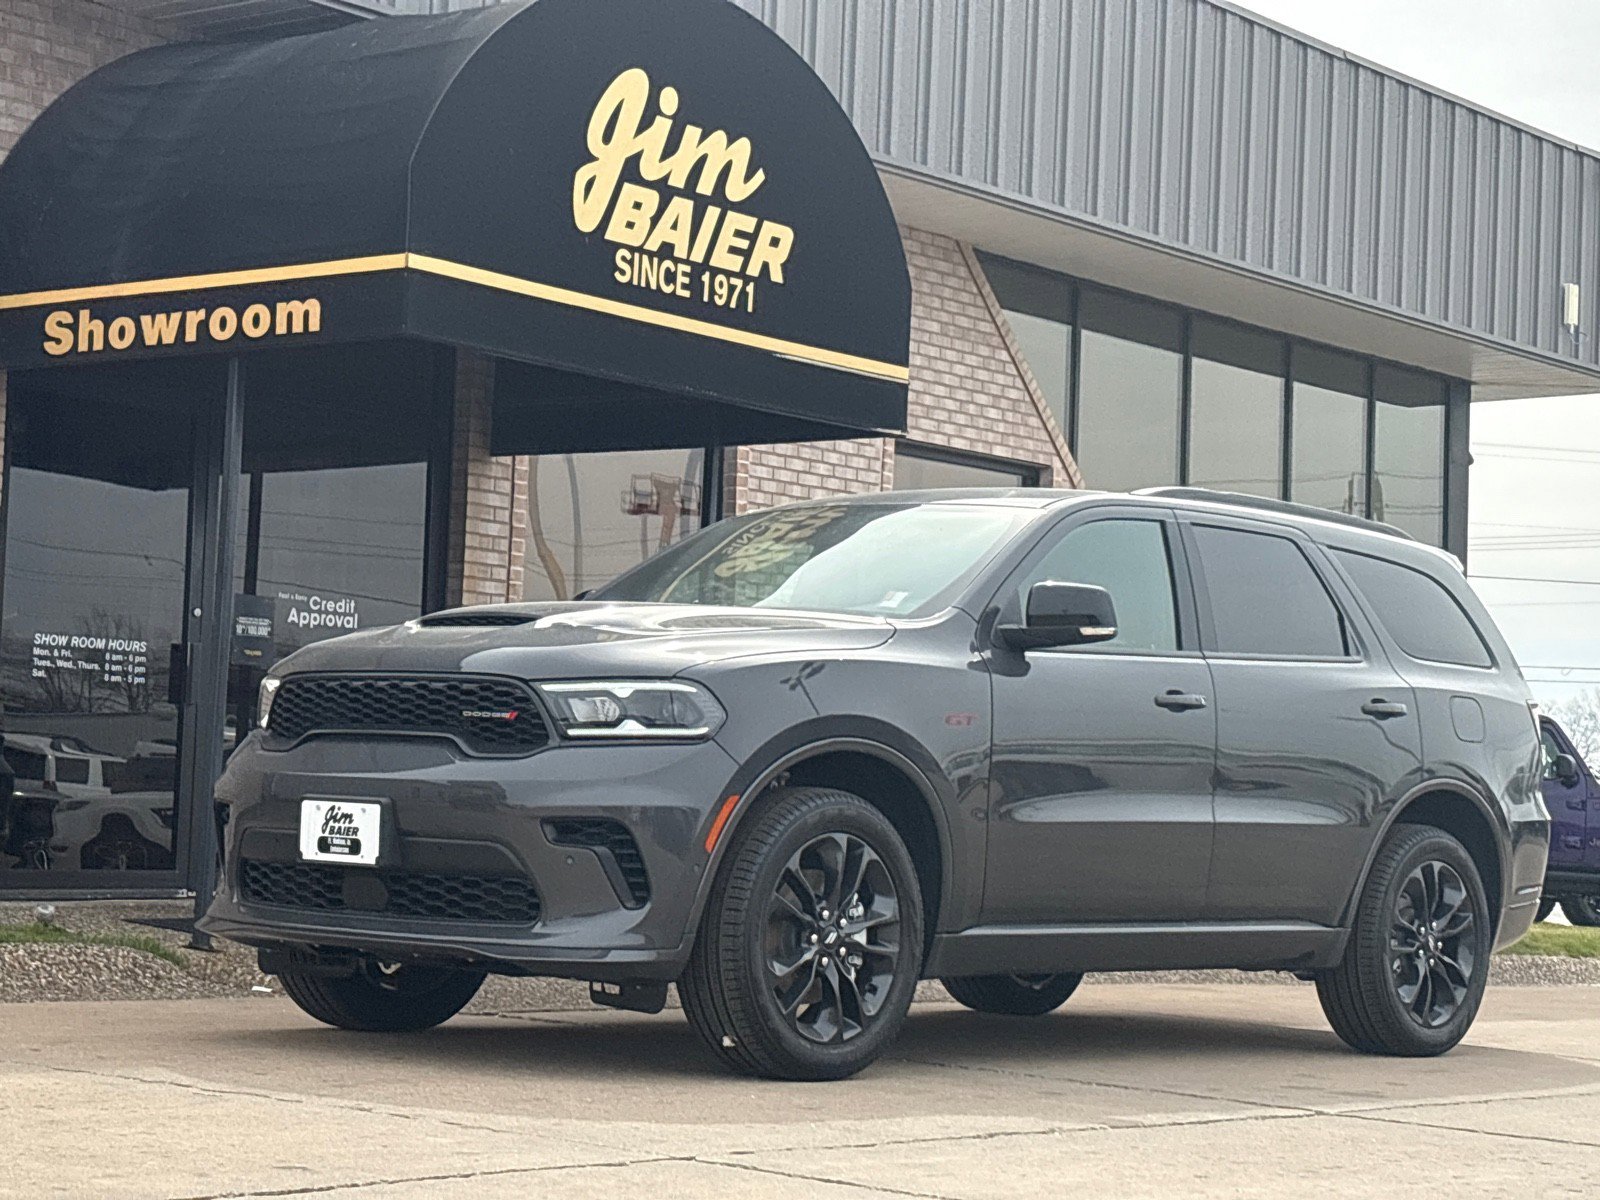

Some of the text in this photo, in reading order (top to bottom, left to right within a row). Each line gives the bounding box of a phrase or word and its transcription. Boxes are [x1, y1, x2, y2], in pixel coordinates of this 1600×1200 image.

[572, 68, 765, 233] Jim
[604, 182, 795, 284] BAIER
[614, 248, 755, 312] SINCE 1971
[43, 298, 321, 356] Showroom
[309, 596, 355, 613] Credit
[287, 607, 359, 629] Approval
[33, 632, 147, 653] SHOW ROOM HOURS
[33, 647, 51, 656] Mon.
[53, 648, 59, 657] &
[60, 649, 73, 658] Fri.
[105, 652, 110, 661] 8
[134, 655, 147, 663] pm
[32, 668, 47, 678] Sat.
[127, 674, 133, 683] 5
[133, 676, 146, 685] pm
[77, 660, 101, 670] Thurs.
[104, 662, 110, 671] 8
[134, 665, 146, 673] pm
[322, 805, 354, 834] Jim
[328, 826, 359, 836] BAIER
